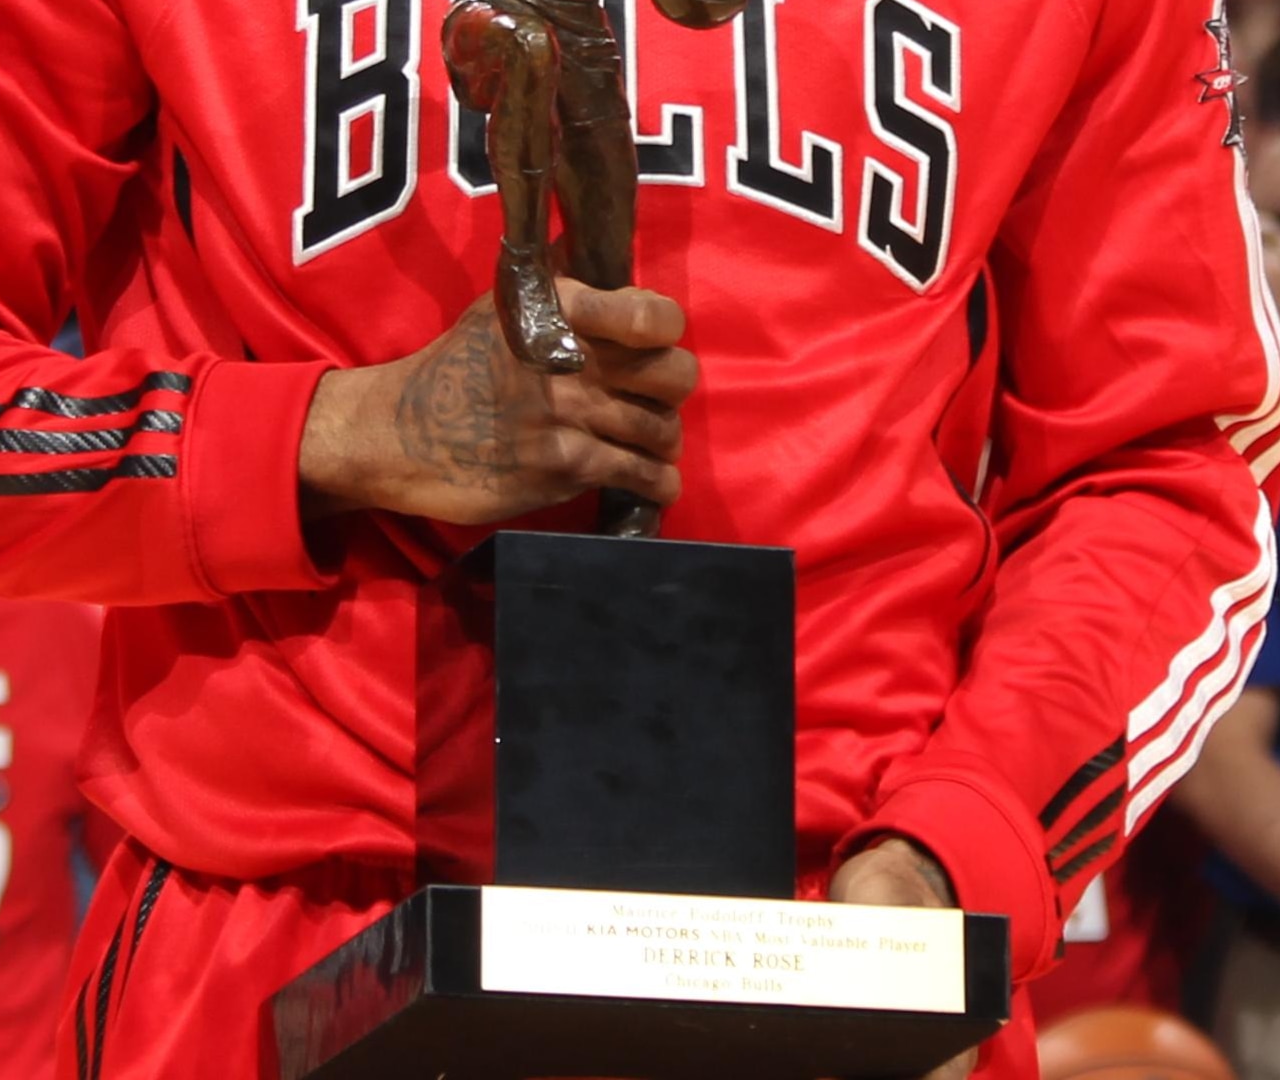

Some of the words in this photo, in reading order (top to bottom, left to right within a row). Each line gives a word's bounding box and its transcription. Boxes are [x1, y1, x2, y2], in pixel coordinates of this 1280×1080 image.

[587, 924, 617, 936] KIA
[626, 925, 701, 941] MOTORS
[644, 946, 736, 968] DERRICK
[753, 952, 805, 972] ROSE
